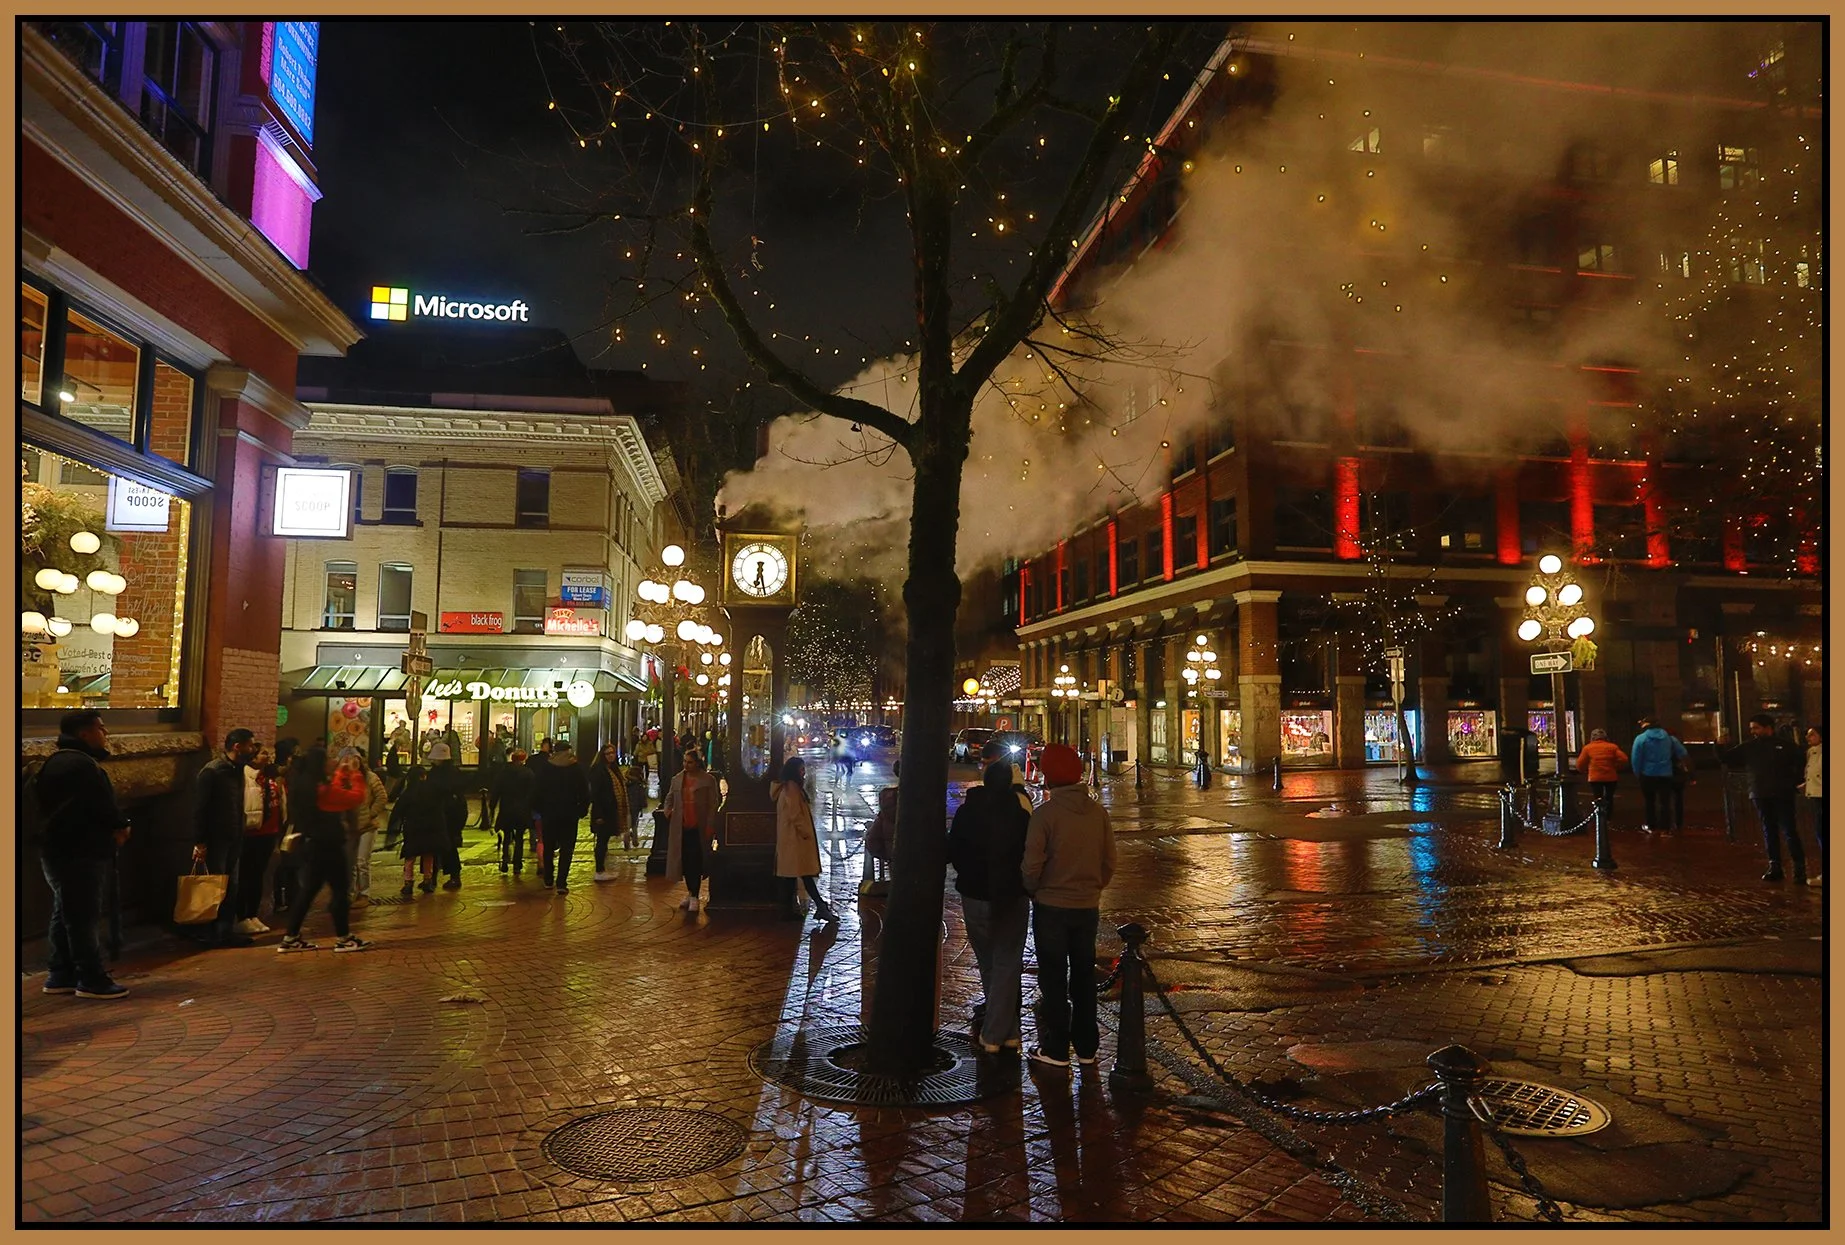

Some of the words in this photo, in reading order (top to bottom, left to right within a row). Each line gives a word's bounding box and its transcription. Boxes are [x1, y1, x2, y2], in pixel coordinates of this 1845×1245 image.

[278, 36, 297, 71] Robert
[280, 56, 296, 84] Marc
[414, 294, 530, 323] Microsoft
[294, 500, 332, 512] SCOOP
[471, 614, 488, 626] black
[488, 614, 503, 629] frog
[547, 618, 599, 632] Michelle's
[61, 647, 88, 658] Voted
[88, 649, 105, 660] Best
[421, 678, 463, 700] Lee's
[465, 681, 559, 701] Donuts
